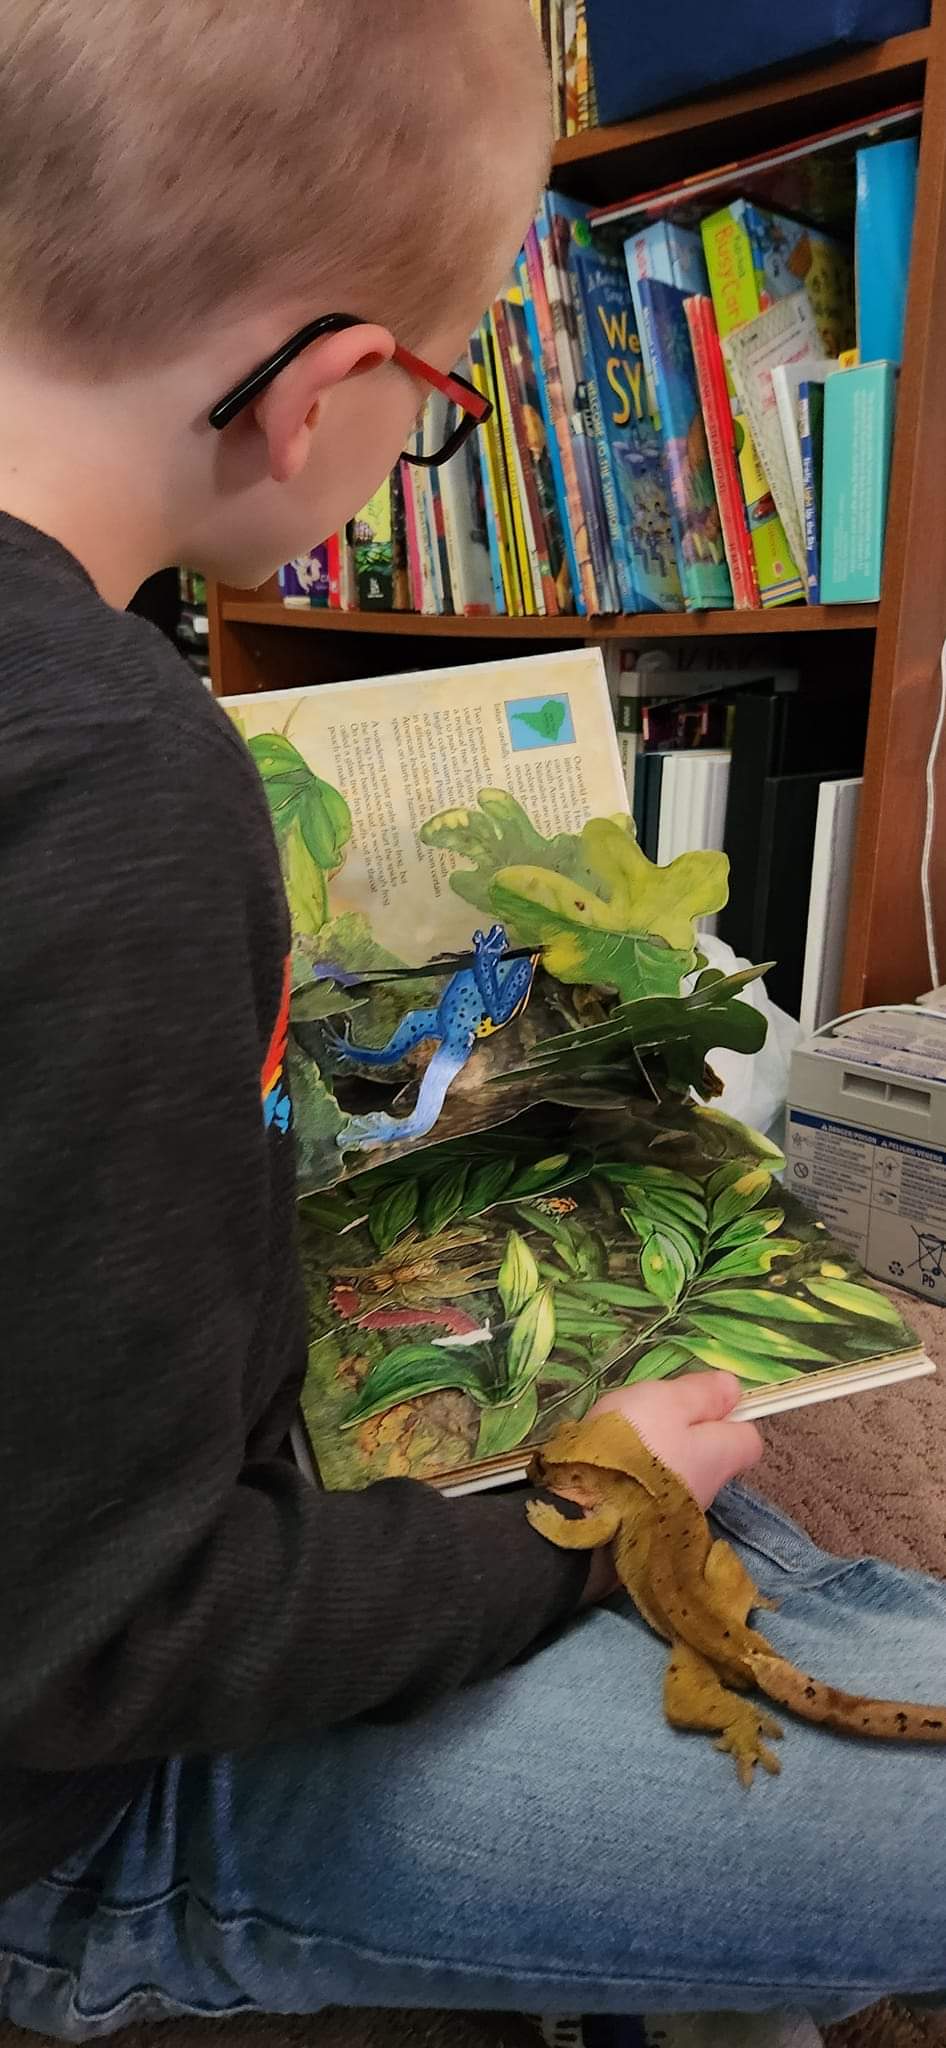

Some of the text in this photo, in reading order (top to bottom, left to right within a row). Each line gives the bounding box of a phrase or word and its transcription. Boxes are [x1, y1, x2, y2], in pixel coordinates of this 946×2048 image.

[606, 357, 643, 425] SY
[584, 378, 604, 436] WELCOME
[601, 482, 621, 541] SYMPHONY
[922, 1273, 935, 1289] Pb
